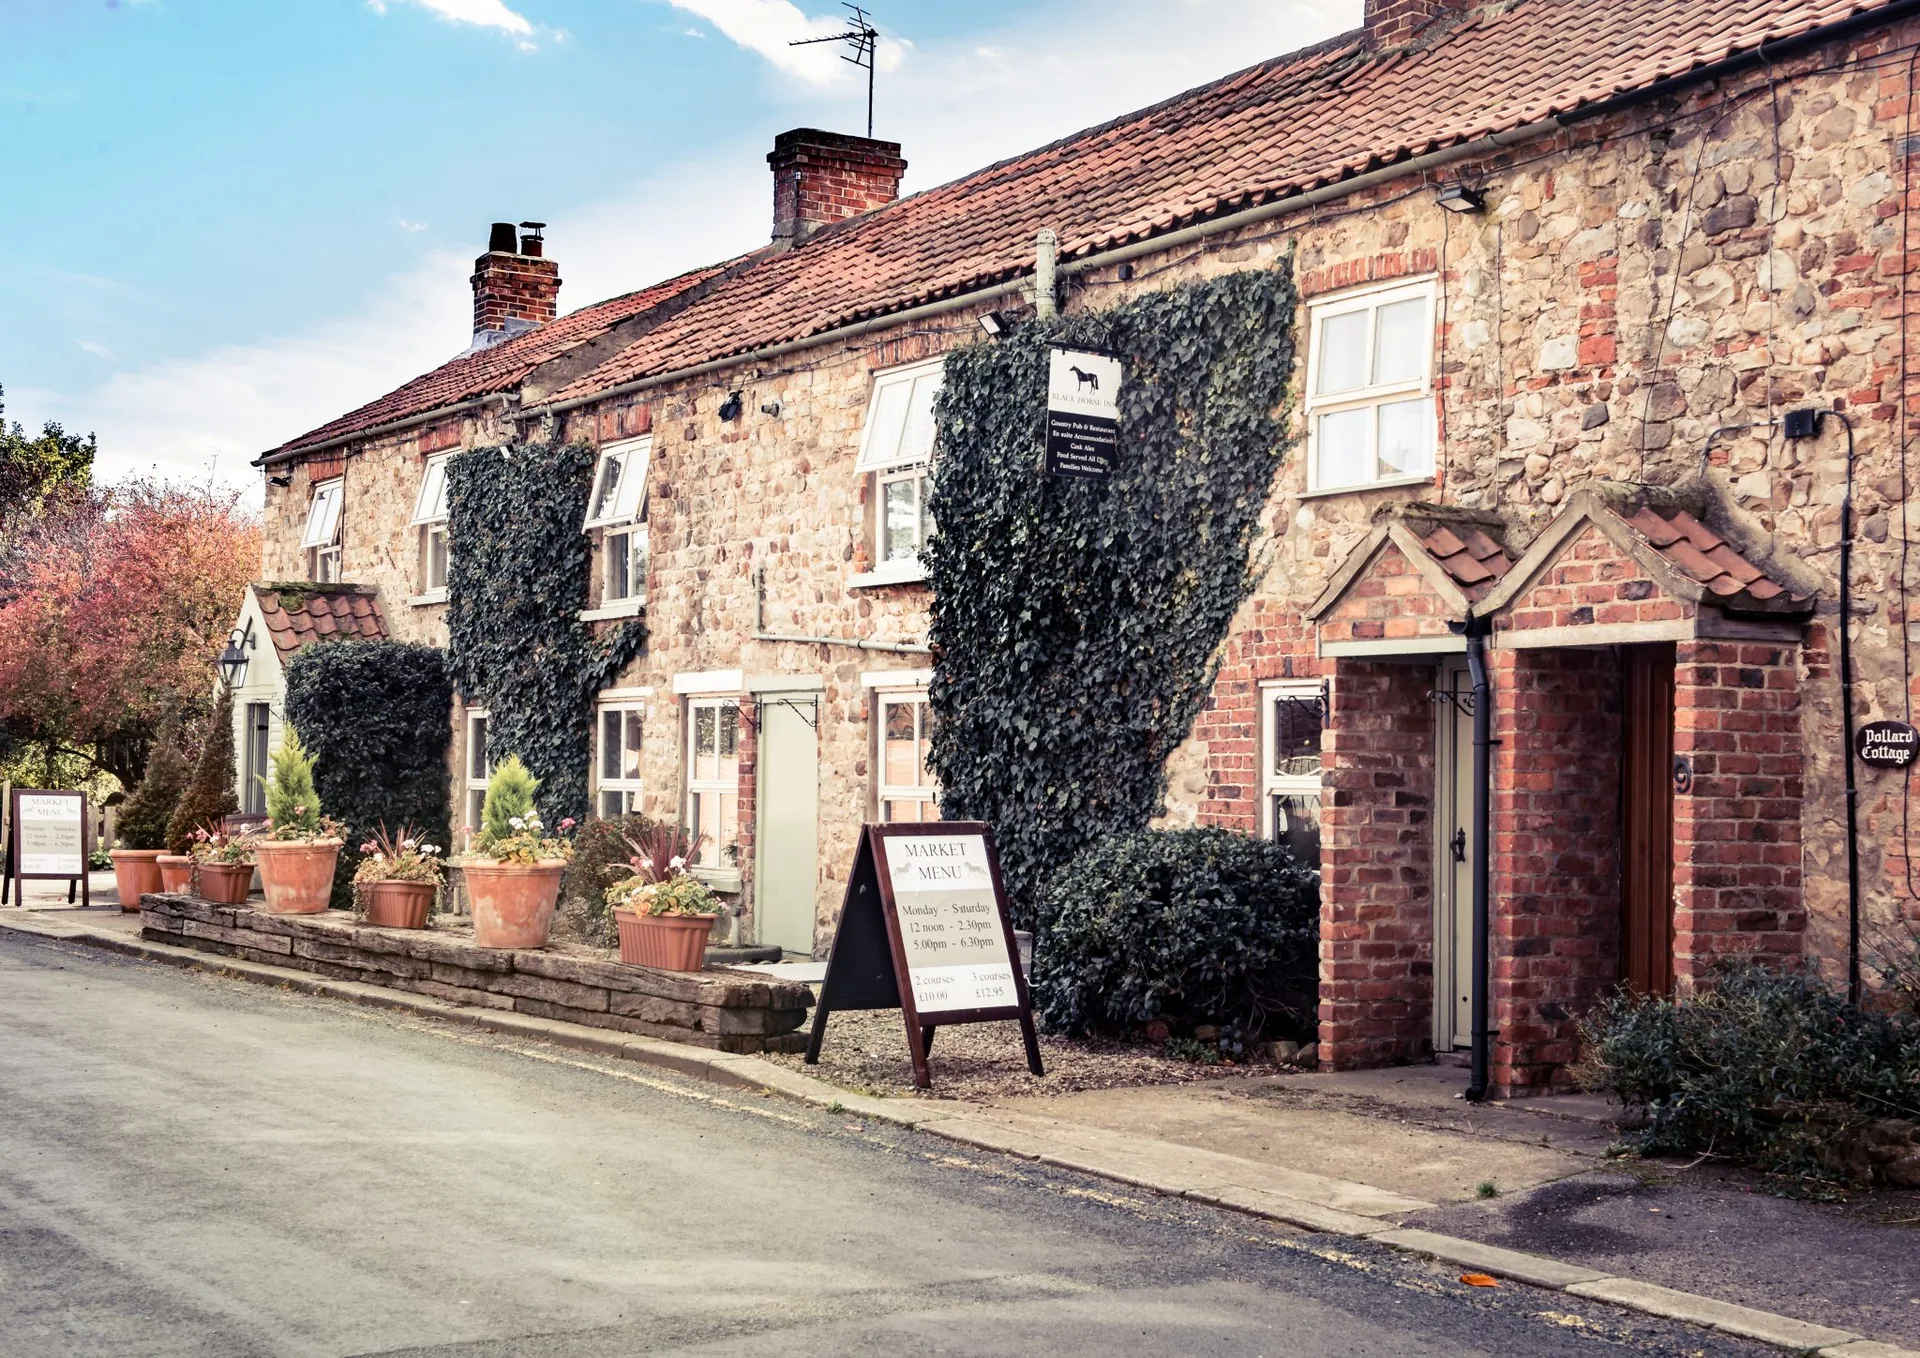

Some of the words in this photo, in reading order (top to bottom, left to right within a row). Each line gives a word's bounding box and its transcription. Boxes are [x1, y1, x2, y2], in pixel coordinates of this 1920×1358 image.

[1052, 393, 1075, 402] BLACK
[1077, 396, 1100, 406] HORSE
[1051, 420, 1071, 429] Country
[1072, 422, 1083, 430] Pub
[1089, 425, 1116, 434] Restaurant
[1074, 433, 1114, 444] Accommodation
[1057, 451, 1070, 459] Food
[1070, 453, 1088, 461] Served
[1060, 462, 1080, 471] Families
[1081, 465, 1104, 473] Welcome
[1865, 729, 1913, 745] Pollard
[1862, 745, 1910, 764] Cottage
[32, 798, 69, 806] MARKET
[904, 843, 967, 857] MARKET
[919, 865, 962, 880] MENU
[902, 904, 939, 917] Monday
[951, 902, 990, 914] Saturday
[910, 922, 920, 933] 12
[922, 923, 945, 932] noon
[958, 920, 992, 932] 2.30pm
[913, 939, 947, 951] 5.00pm
[960, 937, 994, 949] 6.30pm
[916, 975, 921, 985] 2
[922, 975, 956, 985] courses
[972, 972, 977, 982] 3
[979, 972, 1011, 982] courses
[919, 991, 948, 1002] £10.00
[976, 987, 1004, 998] £12.95
